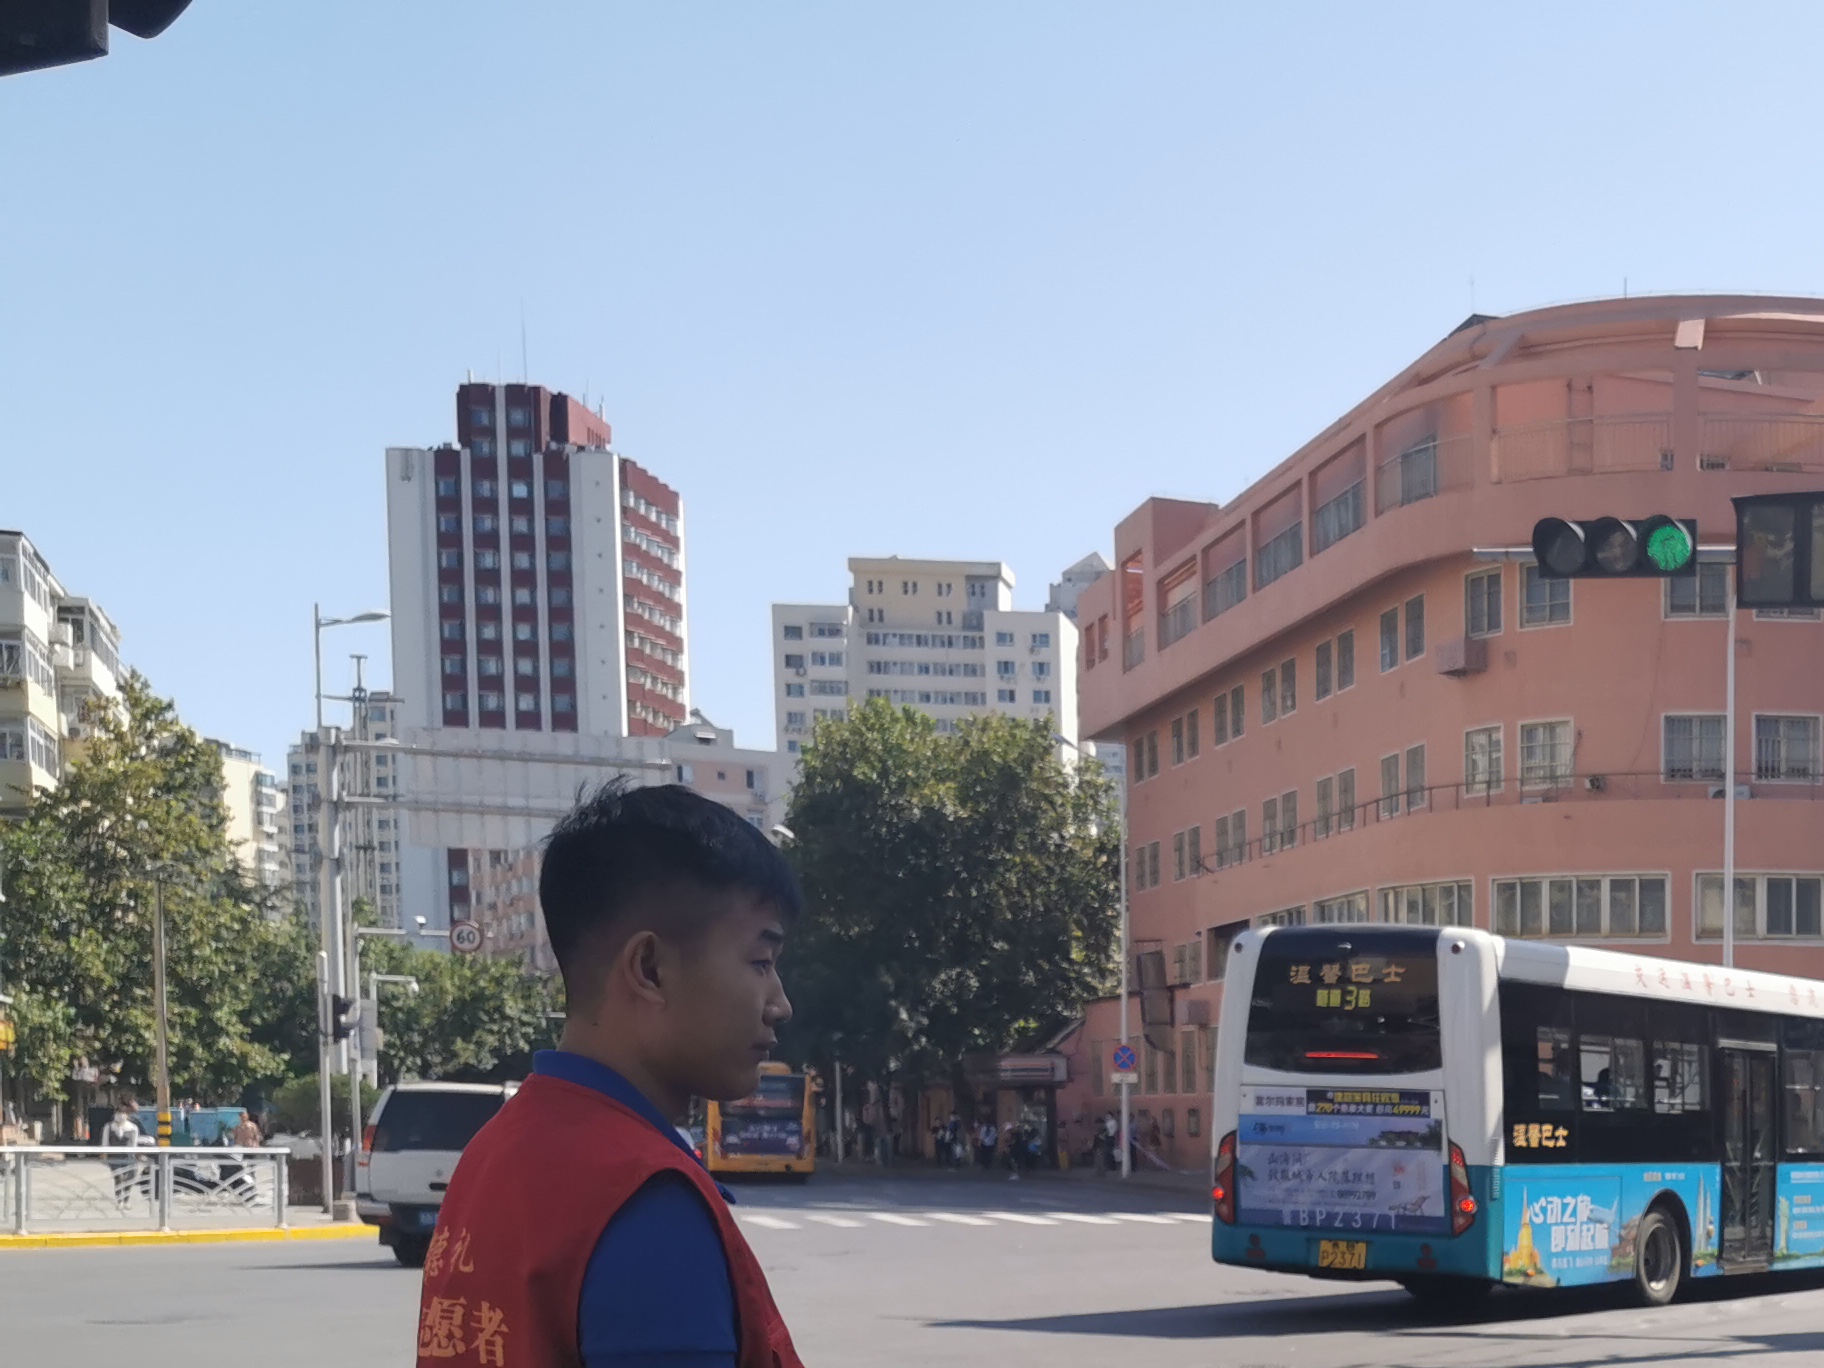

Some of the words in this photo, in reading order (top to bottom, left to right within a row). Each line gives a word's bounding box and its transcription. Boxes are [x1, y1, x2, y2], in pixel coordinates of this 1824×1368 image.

[456, 929, 476, 945] 60
[1289, 963, 1407, 985] 温馨巴士
[1513, 1123, 1569, 1148] 温馨巴士
